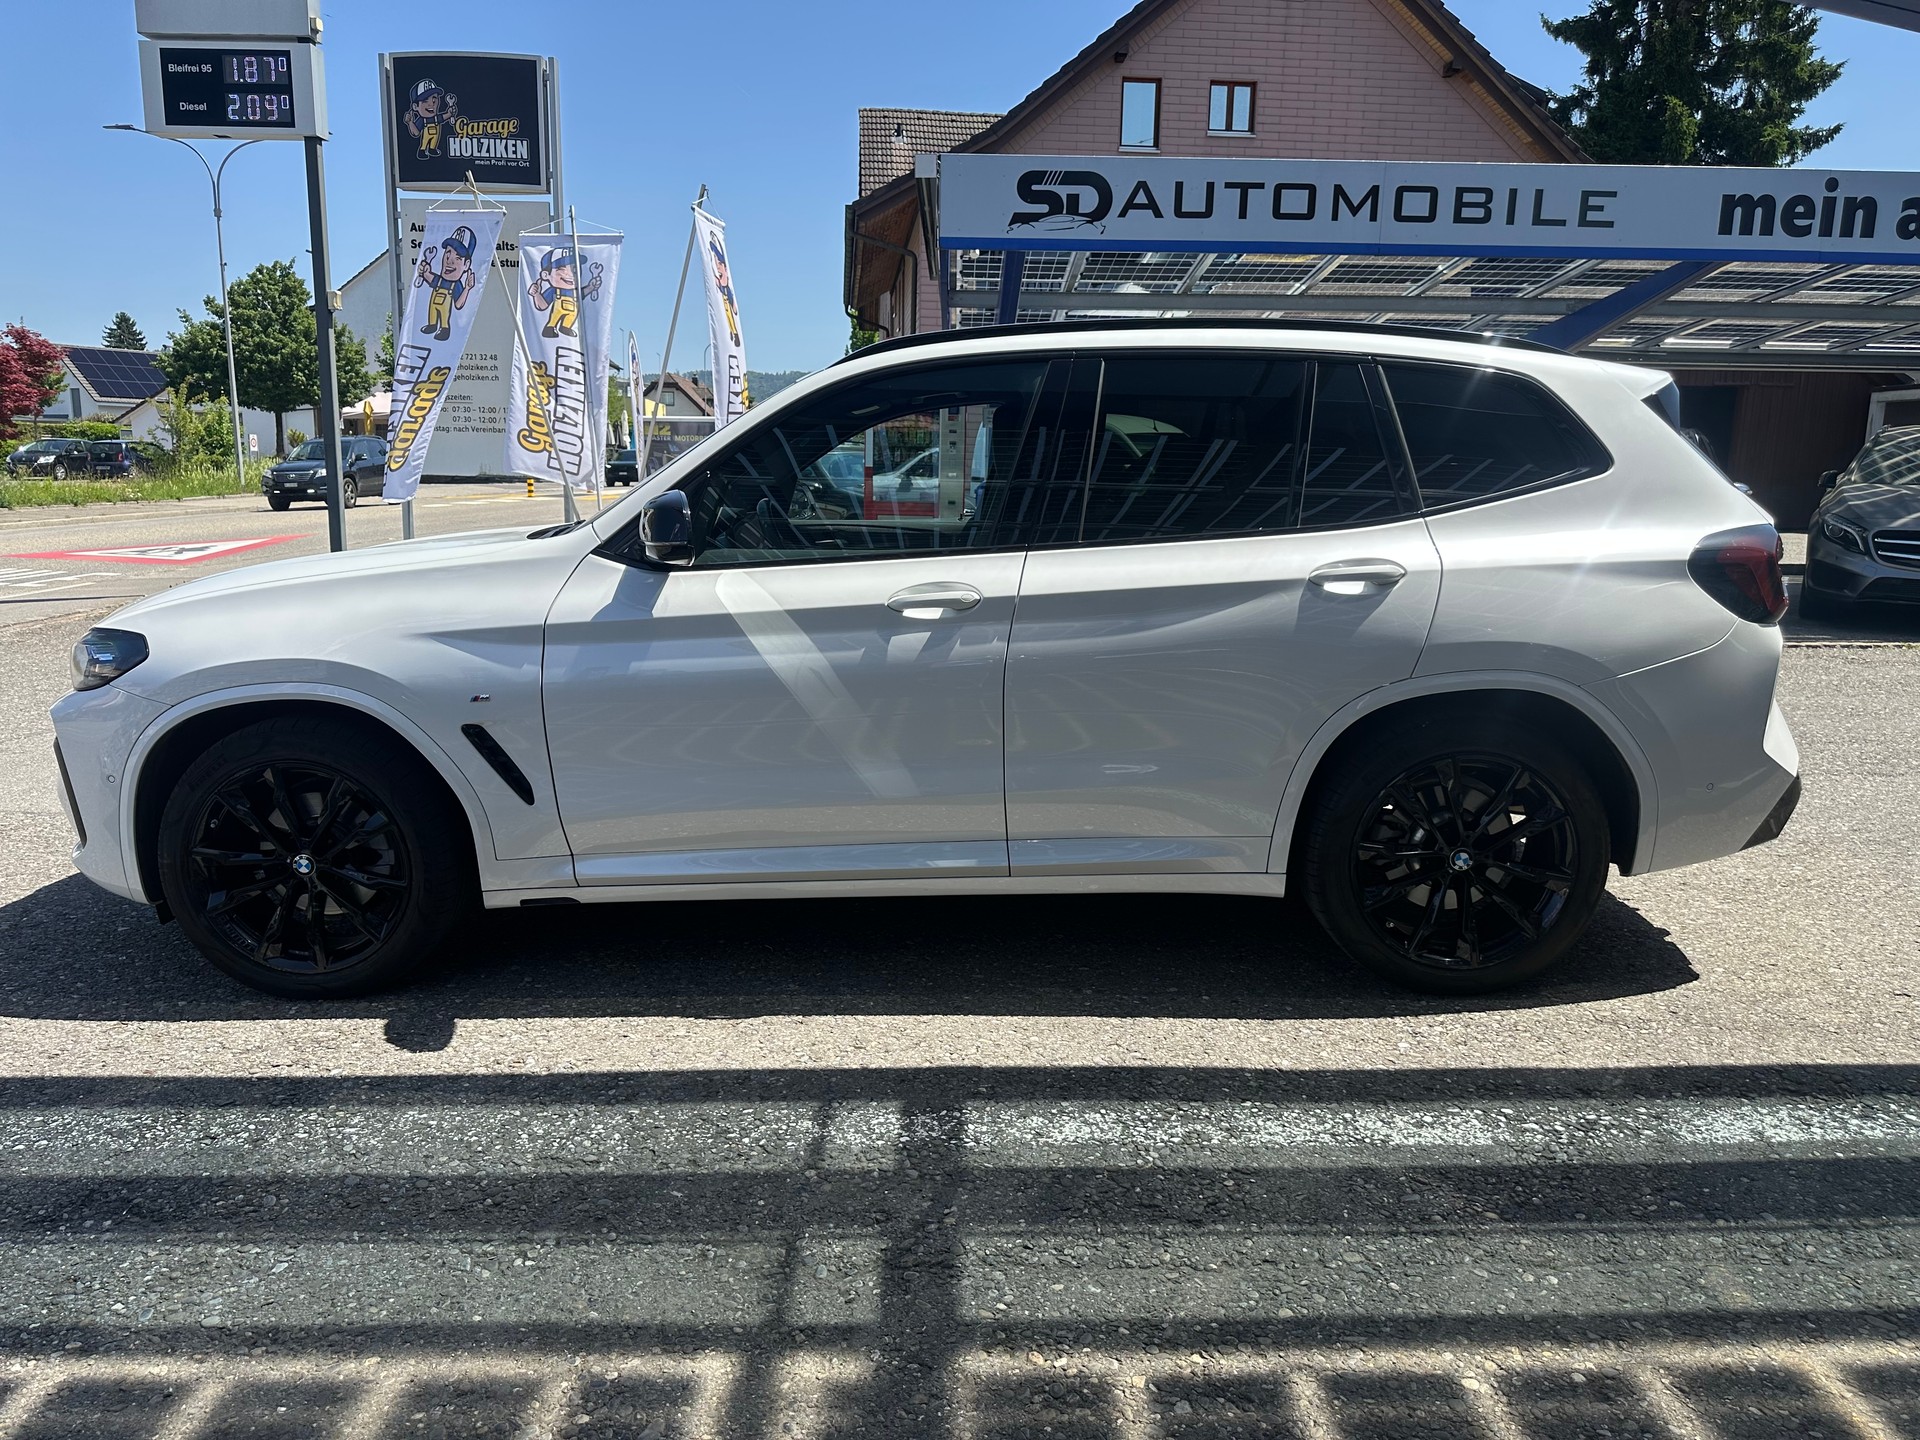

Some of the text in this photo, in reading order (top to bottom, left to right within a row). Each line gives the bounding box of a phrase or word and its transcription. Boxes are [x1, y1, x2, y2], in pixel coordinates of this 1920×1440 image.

[168, 63, 200, 73] Bleifrei
[201, 63, 213, 73] 95
[179, 102, 207, 111] Diesel
[454, 117, 519, 139] Garage
[448, 137, 529, 159] HOLZIKEN
[1008, 169, 1618, 229] SD AUTOMOBILE
[1717, 176, 1878, 239] mein
[465, 353, 477, 361] 721
[451, 405, 471, 413] 07:30
[478, 406, 497, 414] 12:00
[517, 360, 558, 453] Garage
[547, 346, 587, 476] HOLZIKEN
[478, 416, 497, 424] 12:00
